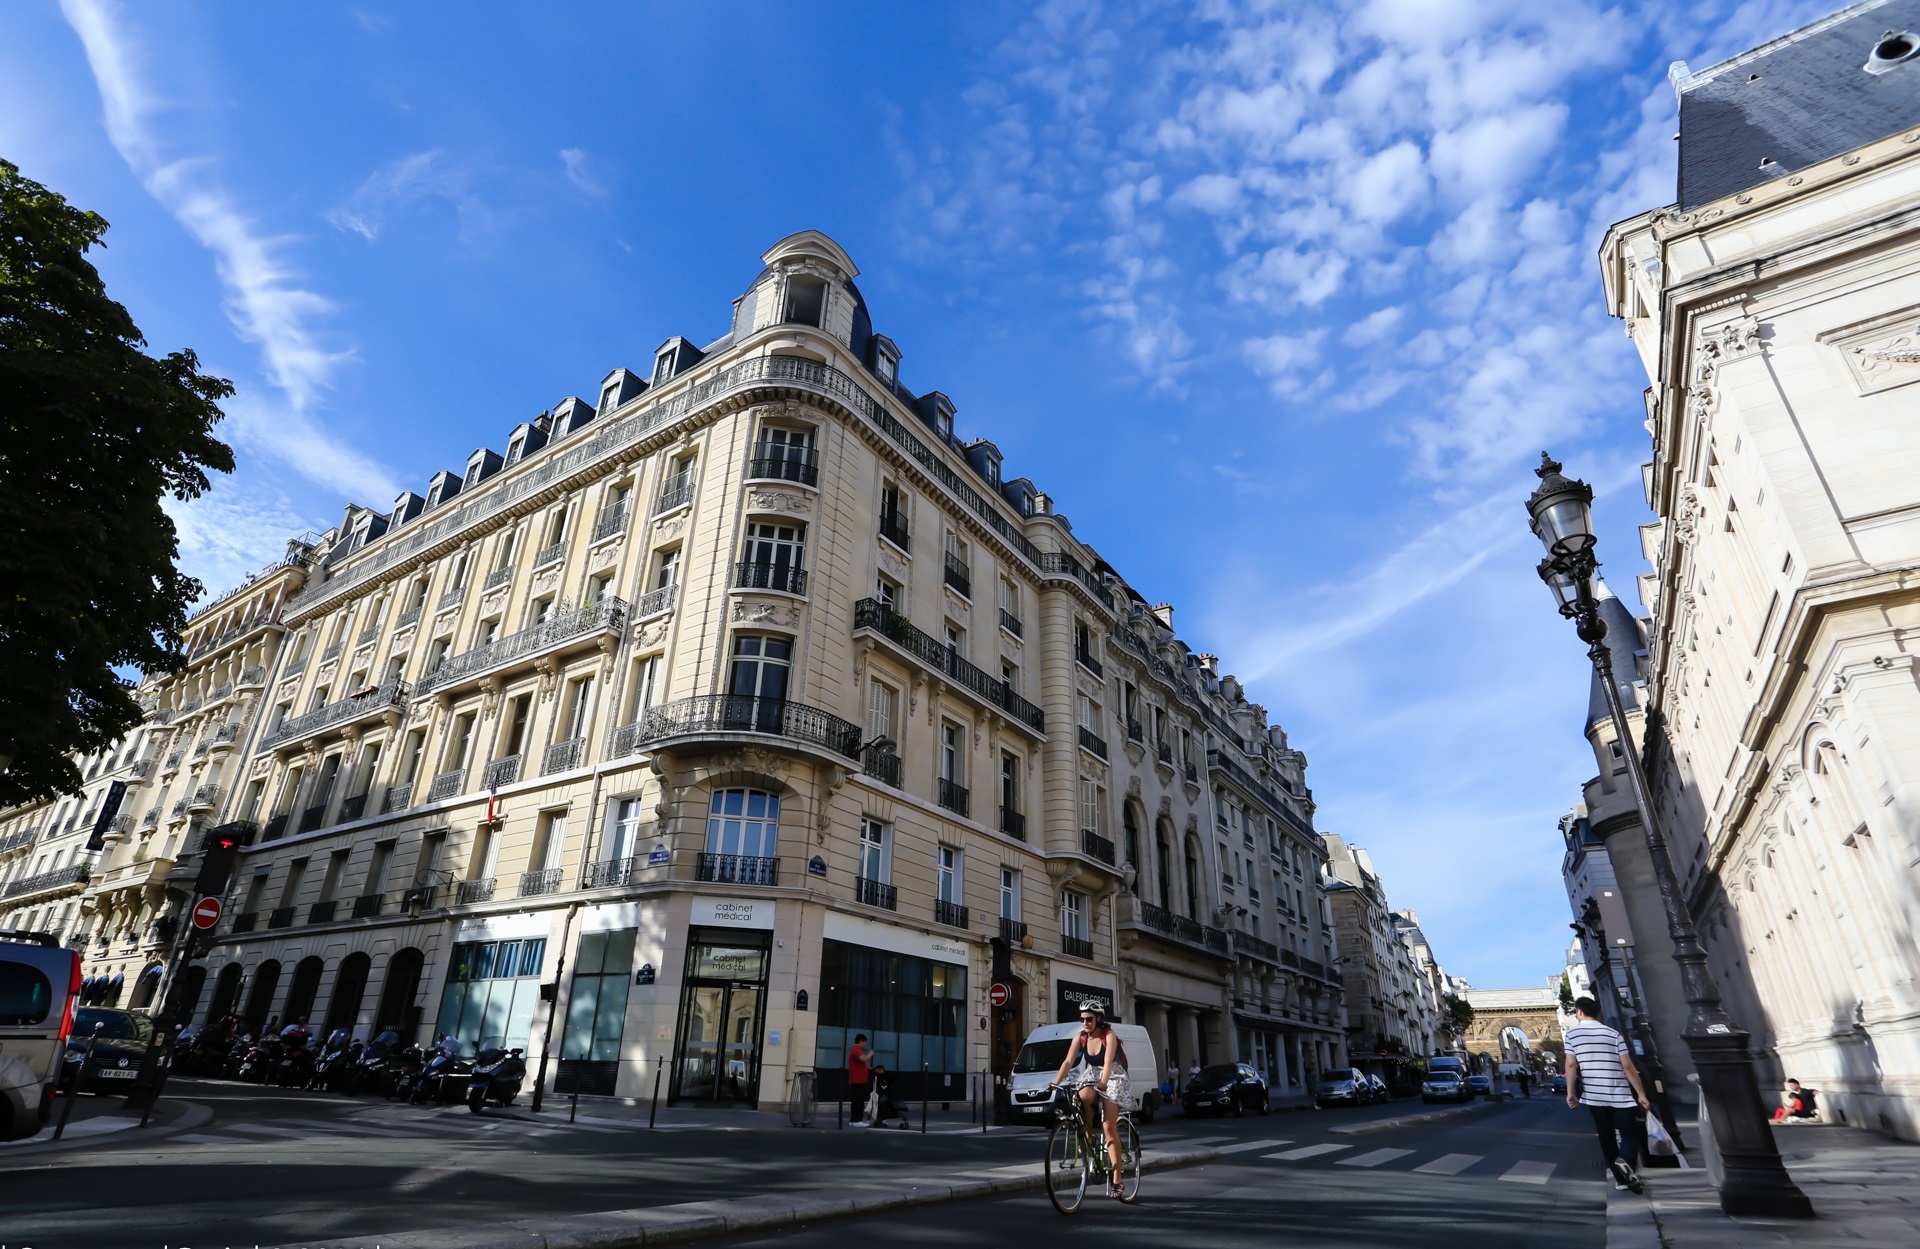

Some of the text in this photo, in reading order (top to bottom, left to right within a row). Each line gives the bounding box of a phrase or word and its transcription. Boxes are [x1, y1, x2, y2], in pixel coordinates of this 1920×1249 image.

[716, 903, 753, 912] cabinet
[714, 912, 752, 921] médical
[713, 963, 746, 971] médical
[1064, 990, 1088, 1002] GALERIE
